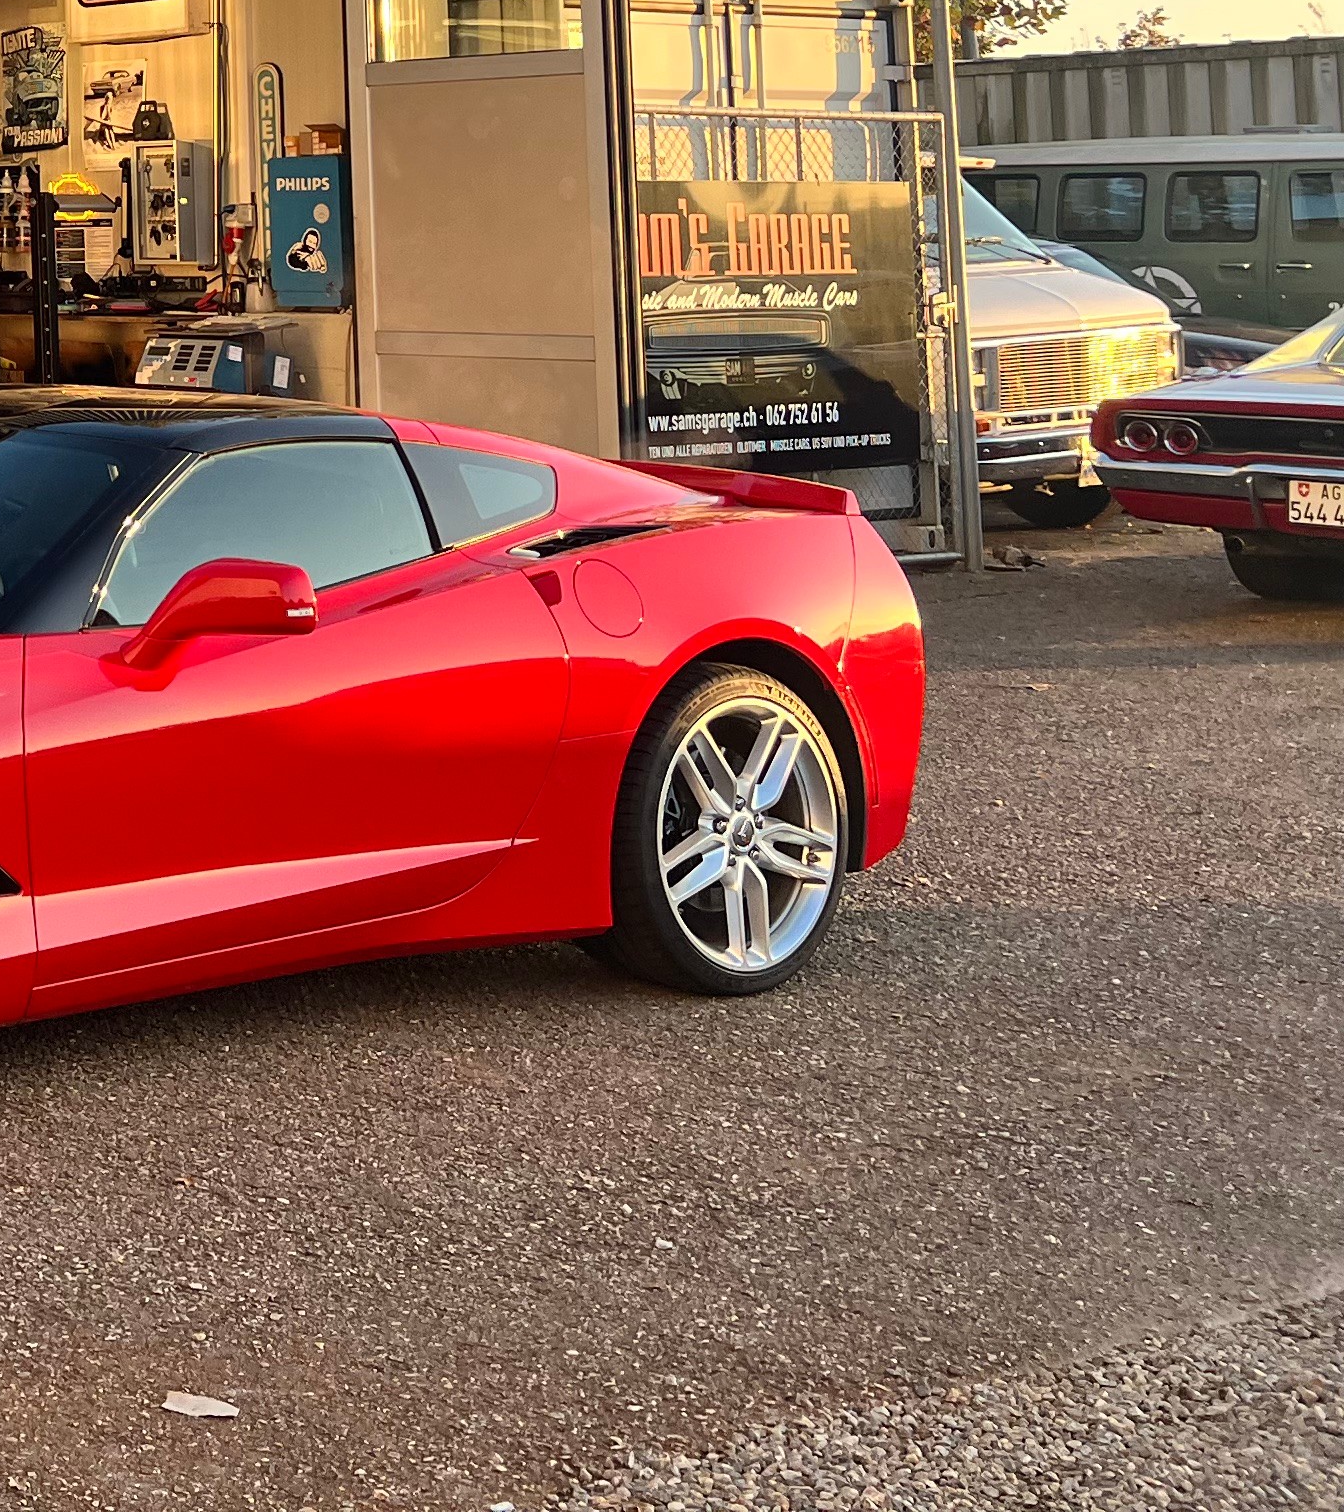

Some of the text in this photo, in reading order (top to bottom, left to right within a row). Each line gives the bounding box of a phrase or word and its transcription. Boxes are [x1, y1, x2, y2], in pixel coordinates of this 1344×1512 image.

[13, 127, 64, 148] PASSION!
[276, 176, 330, 192] PHILIPS
[724, 201, 858, 277] GARAGE
[667, 288, 698, 310] and
[699, 284, 761, 310] Modern
[762, 283, 819, 308] Muscle
[822, 281, 858, 311] Cars
[765, 404, 787, 426] 062
[788, 403, 809, 425] 752
[810, 402, 824, 424] 61
[825, 401, 840, 423] 56
[675, 443, 691, 457] ALLE
[1320, 483, 1342, 501] AG
